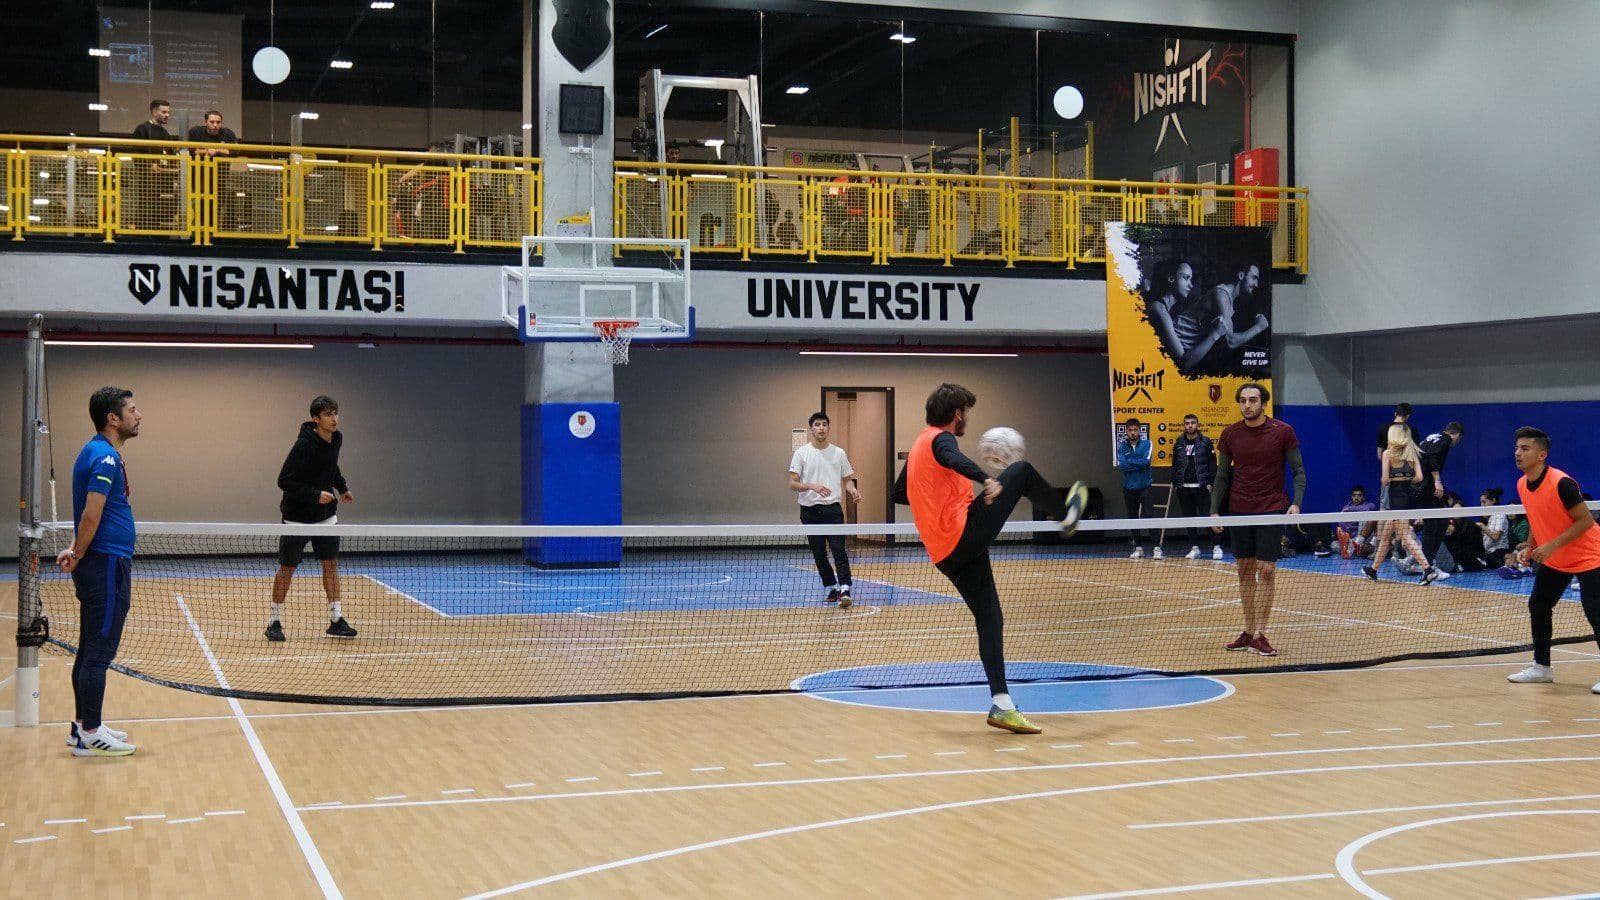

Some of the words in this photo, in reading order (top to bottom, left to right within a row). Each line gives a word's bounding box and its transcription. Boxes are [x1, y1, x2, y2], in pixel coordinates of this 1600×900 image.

[1133, 48, 1211, 123] NISHFIT
[747, 278, 981, 321] UNIVERSITY
[1112, 368, 1165, 392] NISHFIT
